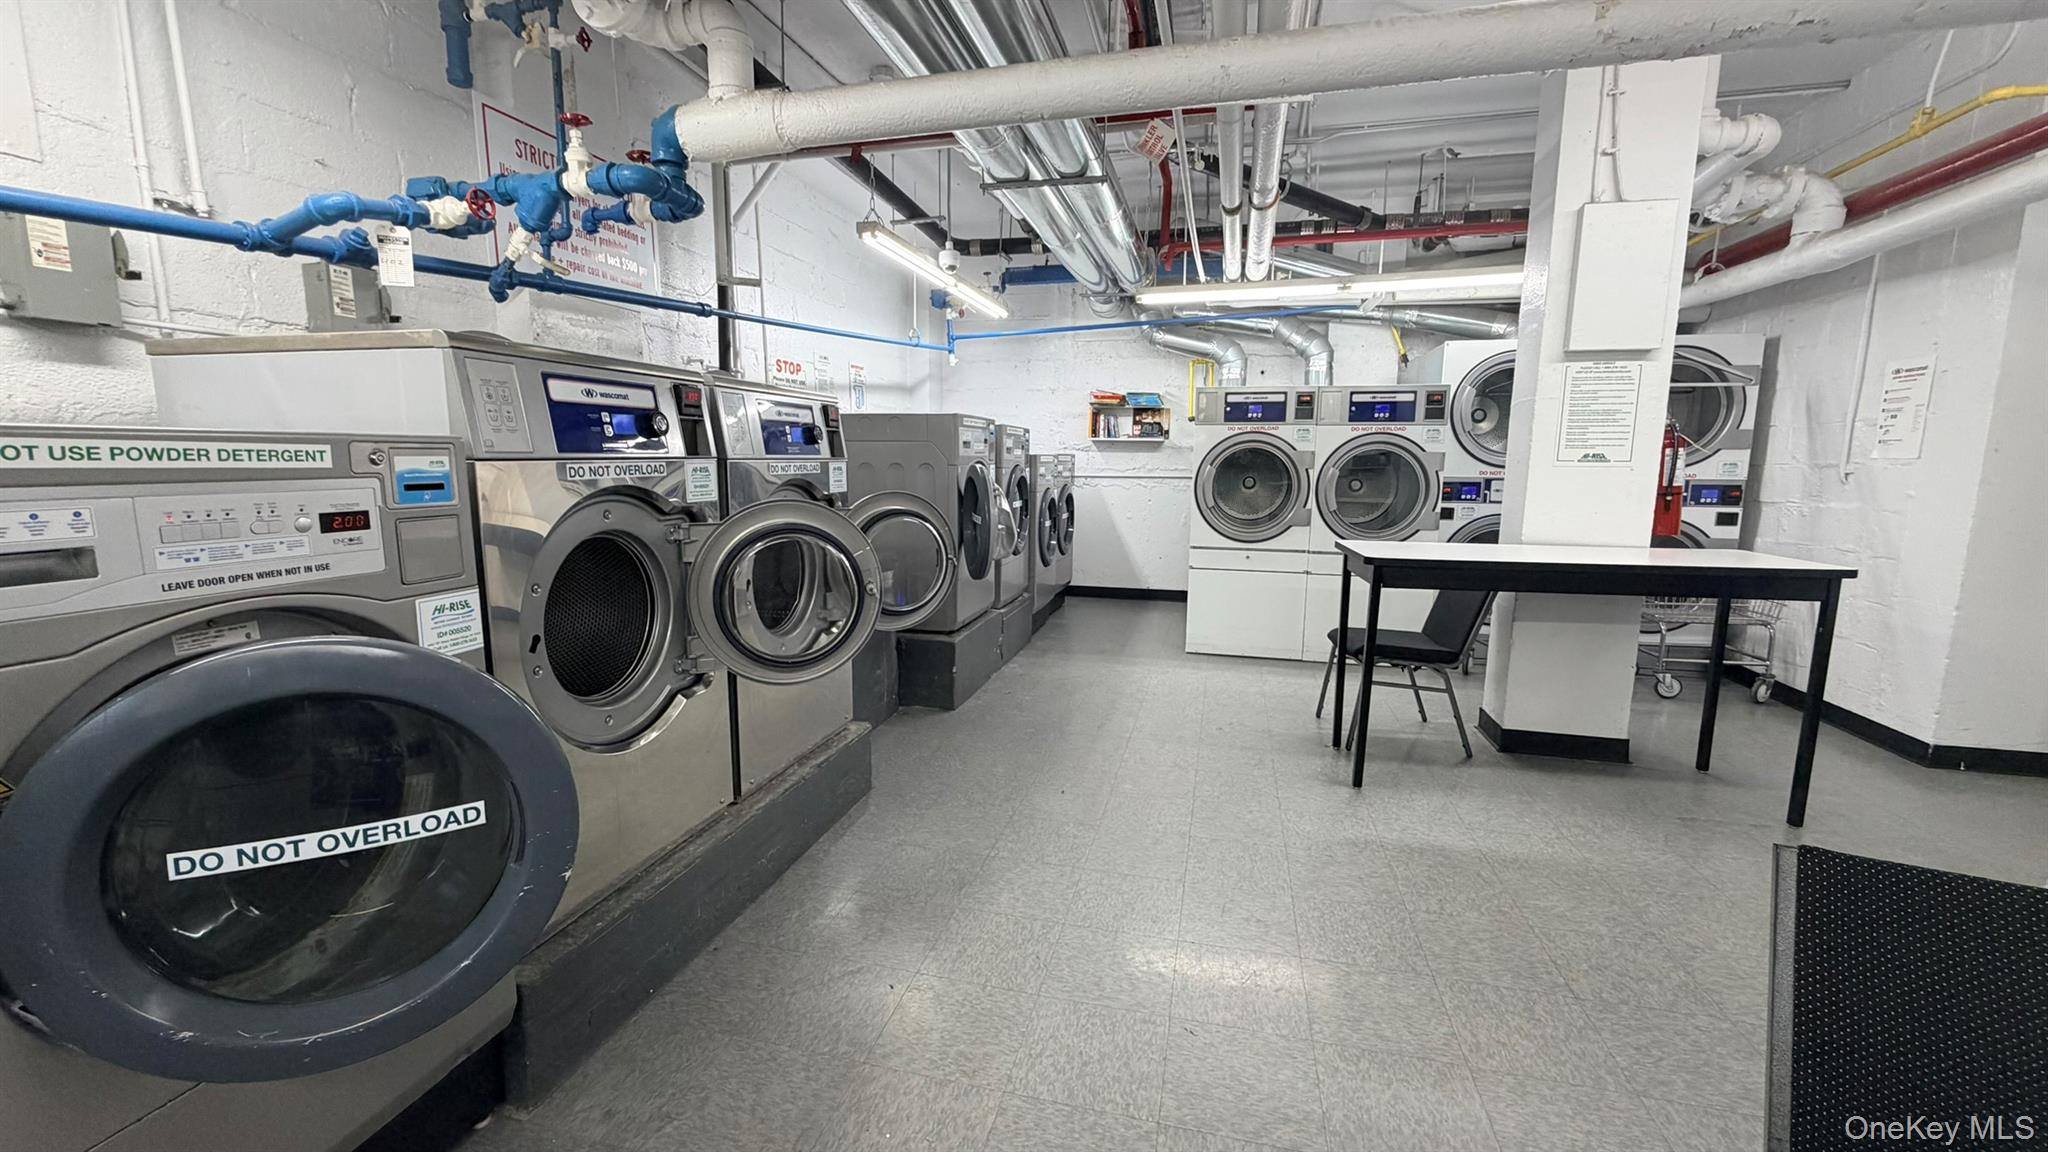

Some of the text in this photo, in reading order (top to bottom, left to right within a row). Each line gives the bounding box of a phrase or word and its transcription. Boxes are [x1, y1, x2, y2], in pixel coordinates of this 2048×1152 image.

[775, 359, 802, 376] STOP
[599, 391, 630, 400] wascomat
[47, 445, 103, 461] USE
[109, 446, 212, 463] POWDER
[217, 448, 327, 463] DETERGENT
[568, 463, 666, 478] DO NOT OVERLOAD
[770, 463, 820, 473] DO NOT OVERLOAD
[161, 562, 331, 593] LEAVE DOOR OPEN WHEN NOT IN USE
[431, 599, 472, 616] HI-RISE
[173, 805, 482, 876] DO NOT OVERLOAD
